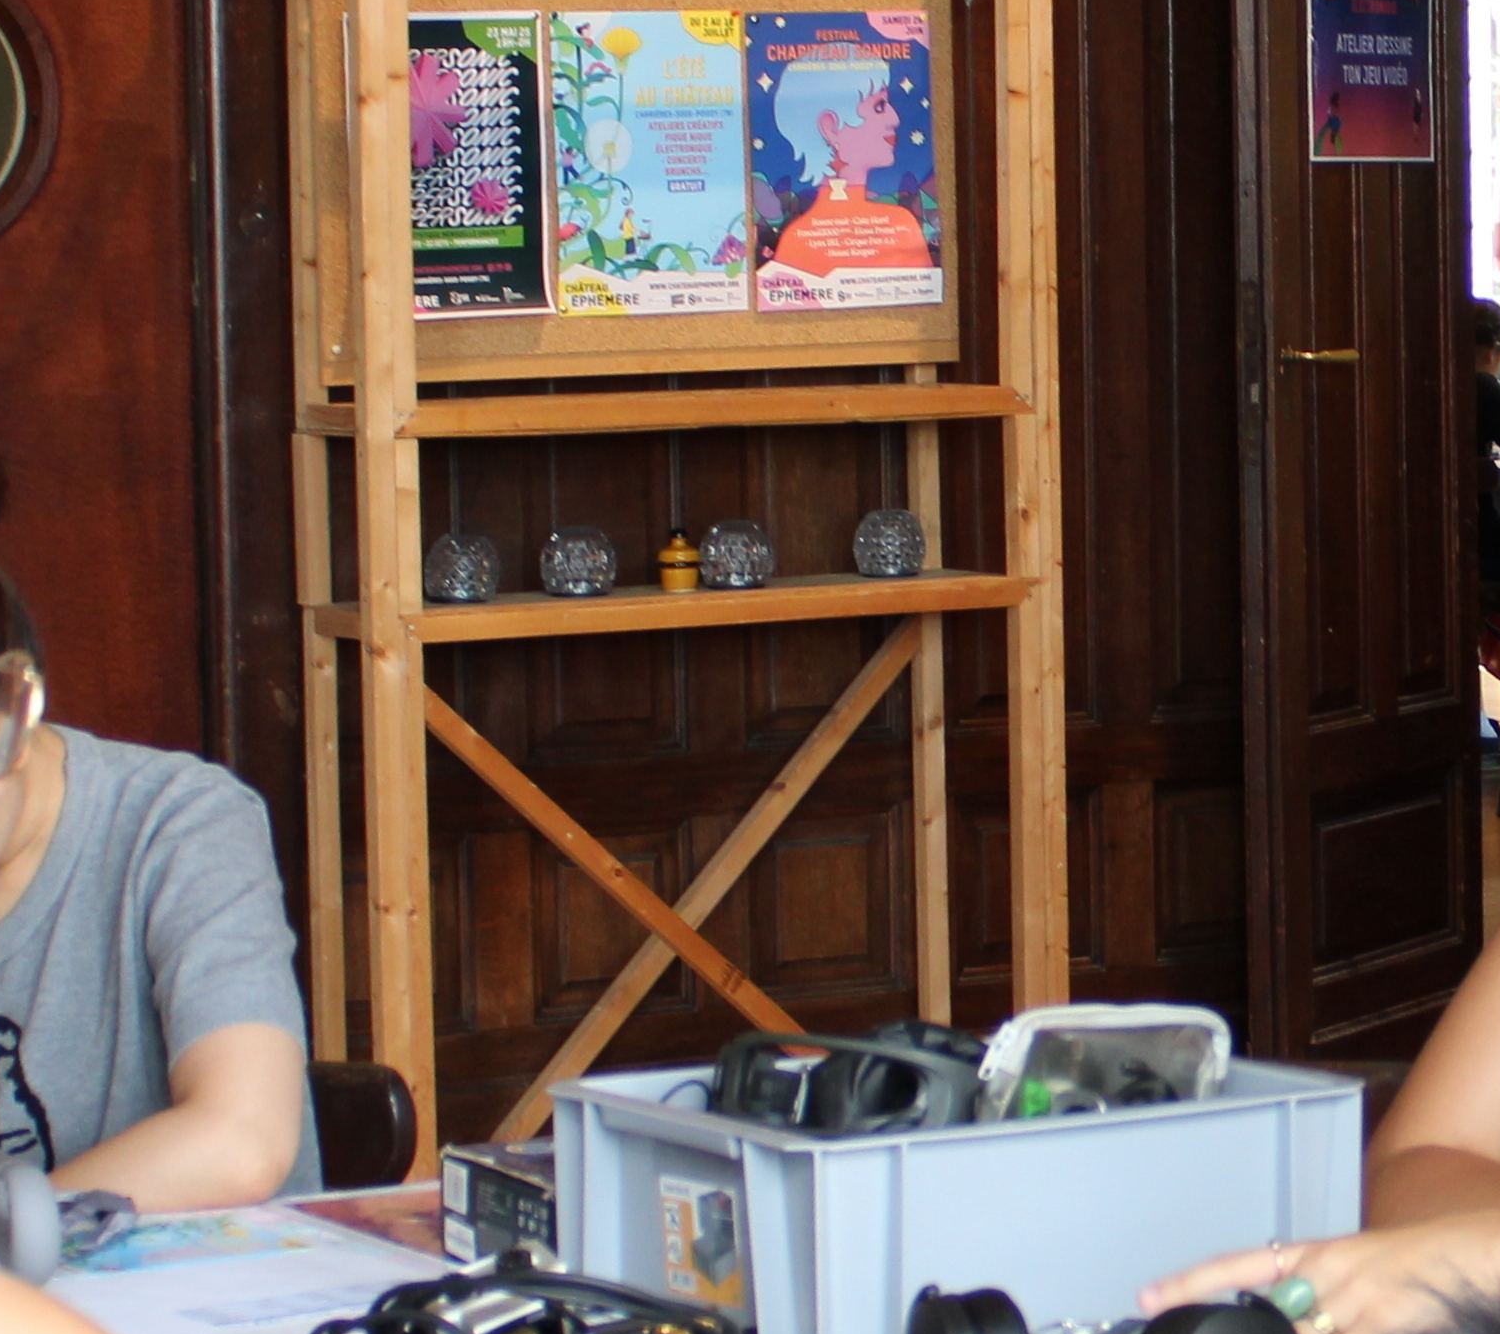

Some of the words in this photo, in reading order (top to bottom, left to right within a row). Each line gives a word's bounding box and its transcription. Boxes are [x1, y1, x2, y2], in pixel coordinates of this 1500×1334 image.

[815, 29, 861, 41] FESTIVAL
[1336, 33, 1375, 54] ATELIER
[766, 43, 850, 62] CHAPITEAU
[663, 55, 706, 79] L'ÉTÉ
[635, 86, 656, 107] AU
[663, 82, 734, 107] CHÂTEAU
